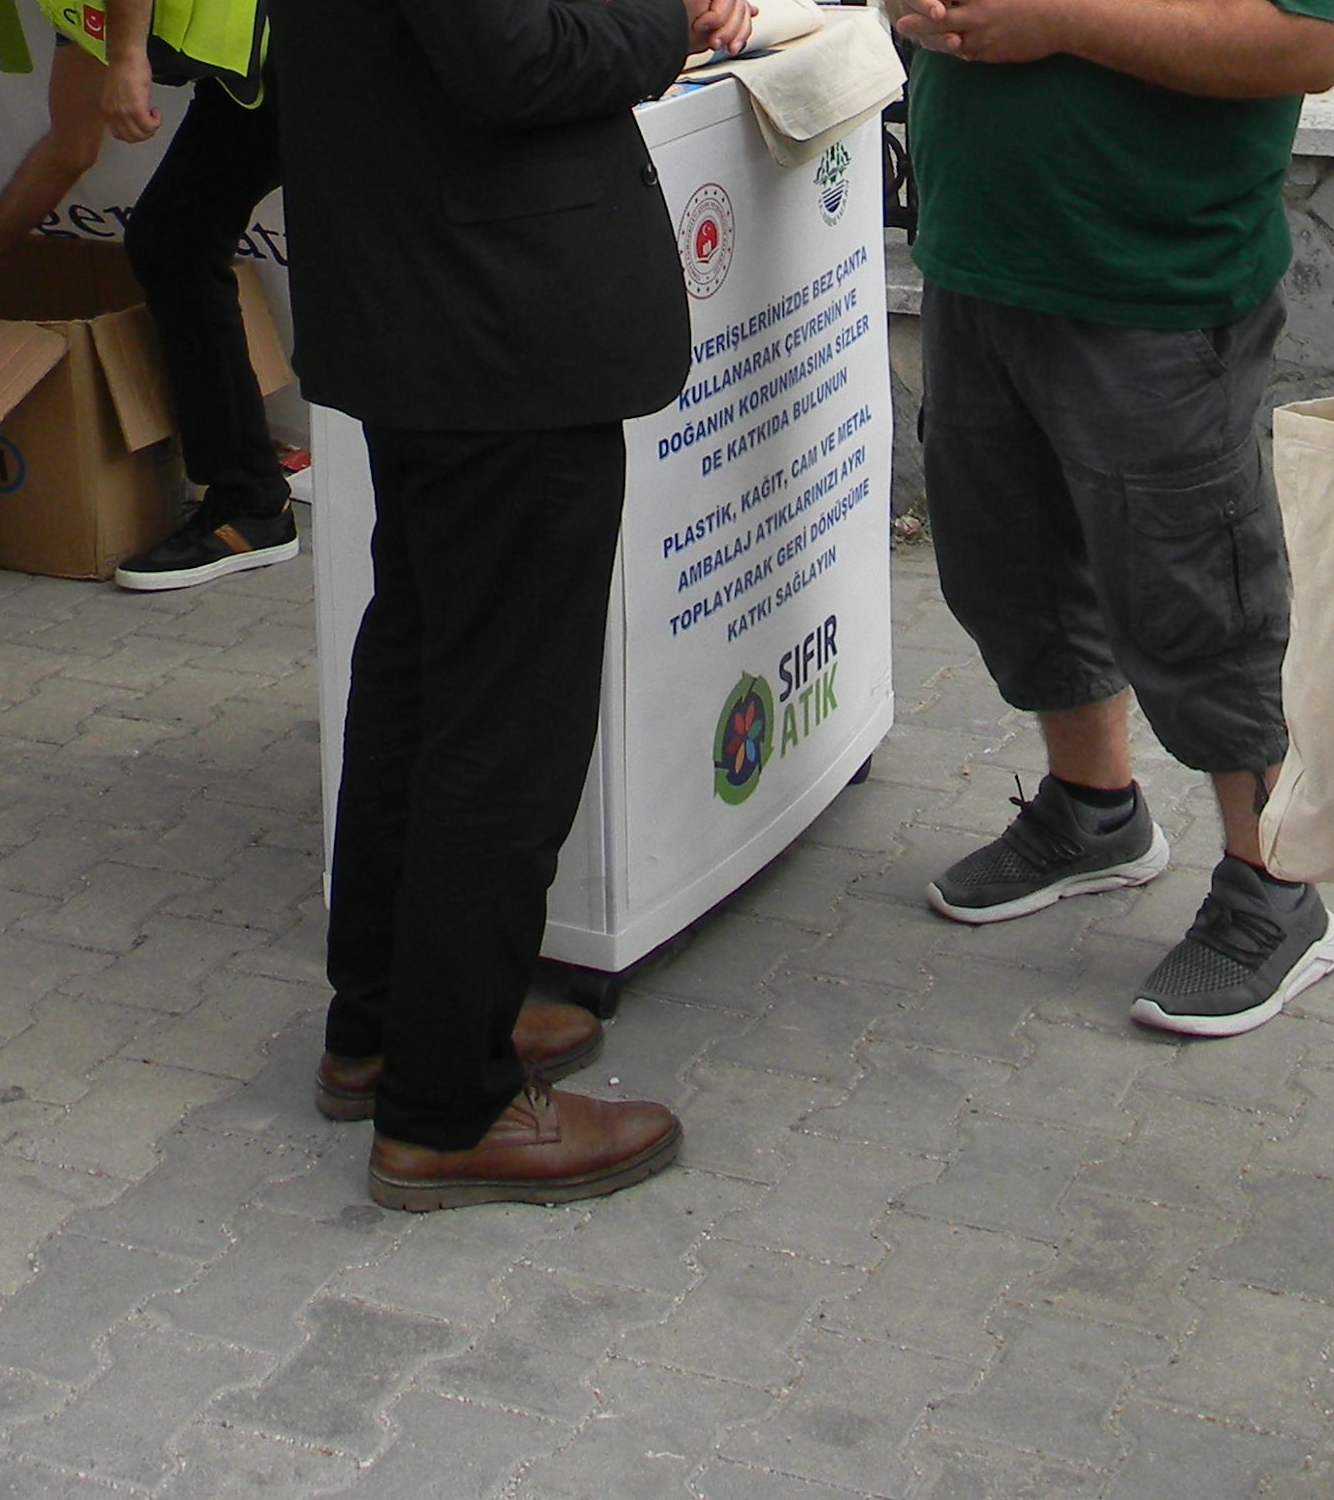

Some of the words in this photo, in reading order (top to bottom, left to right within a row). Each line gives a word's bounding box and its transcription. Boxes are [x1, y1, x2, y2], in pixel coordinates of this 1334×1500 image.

[678, 340, 781, 412] KULLANARAK
[784, 299, 843, 359] ÇEVRENİN
[844, 288, 858, 312] VE
[693, 286, 809, 365] VERİŞLERİNİZDE
[812, 269, 834, 300] BEZ
[836, 246, 868, 288] ÇANTA
[657, 404, 735, 461] DOĞANIN
[738, 343, 833, 419] KORUNMASINA
[835, 314, 870, 355] SİZLER
[701, 448, 723, 477] DE
[727, 409, 790, 462] KATKIDA
[793, 366, 848, 421] BULUNUN
[662, 502, 737, 559] PLASTİK,
[740, 468, 788, 515] KAĞIT,
[791, 445, 818, 480] CAM
[820, 432, 836, 458] VE
[837, 404, 873, 445] METAL
[677, 530, 753, 593] AMBALAJ
[755, 468, 839, 544] ATIKLARINIZI
[840, 445, 866, 482] AYRI
[669, 555, 774, 638] TOPLAYARAK
[776, 526, 808, 568] GERİ
[810, 477, 871, 543] DÖNÜŞÜME
[727, 595, 772, 643] KATKI
[775, 545, 837, 607] SAĞLAYIN
[778, 614, 838, 703] SIFIR
[779, 661, 839, 759] ATIK
